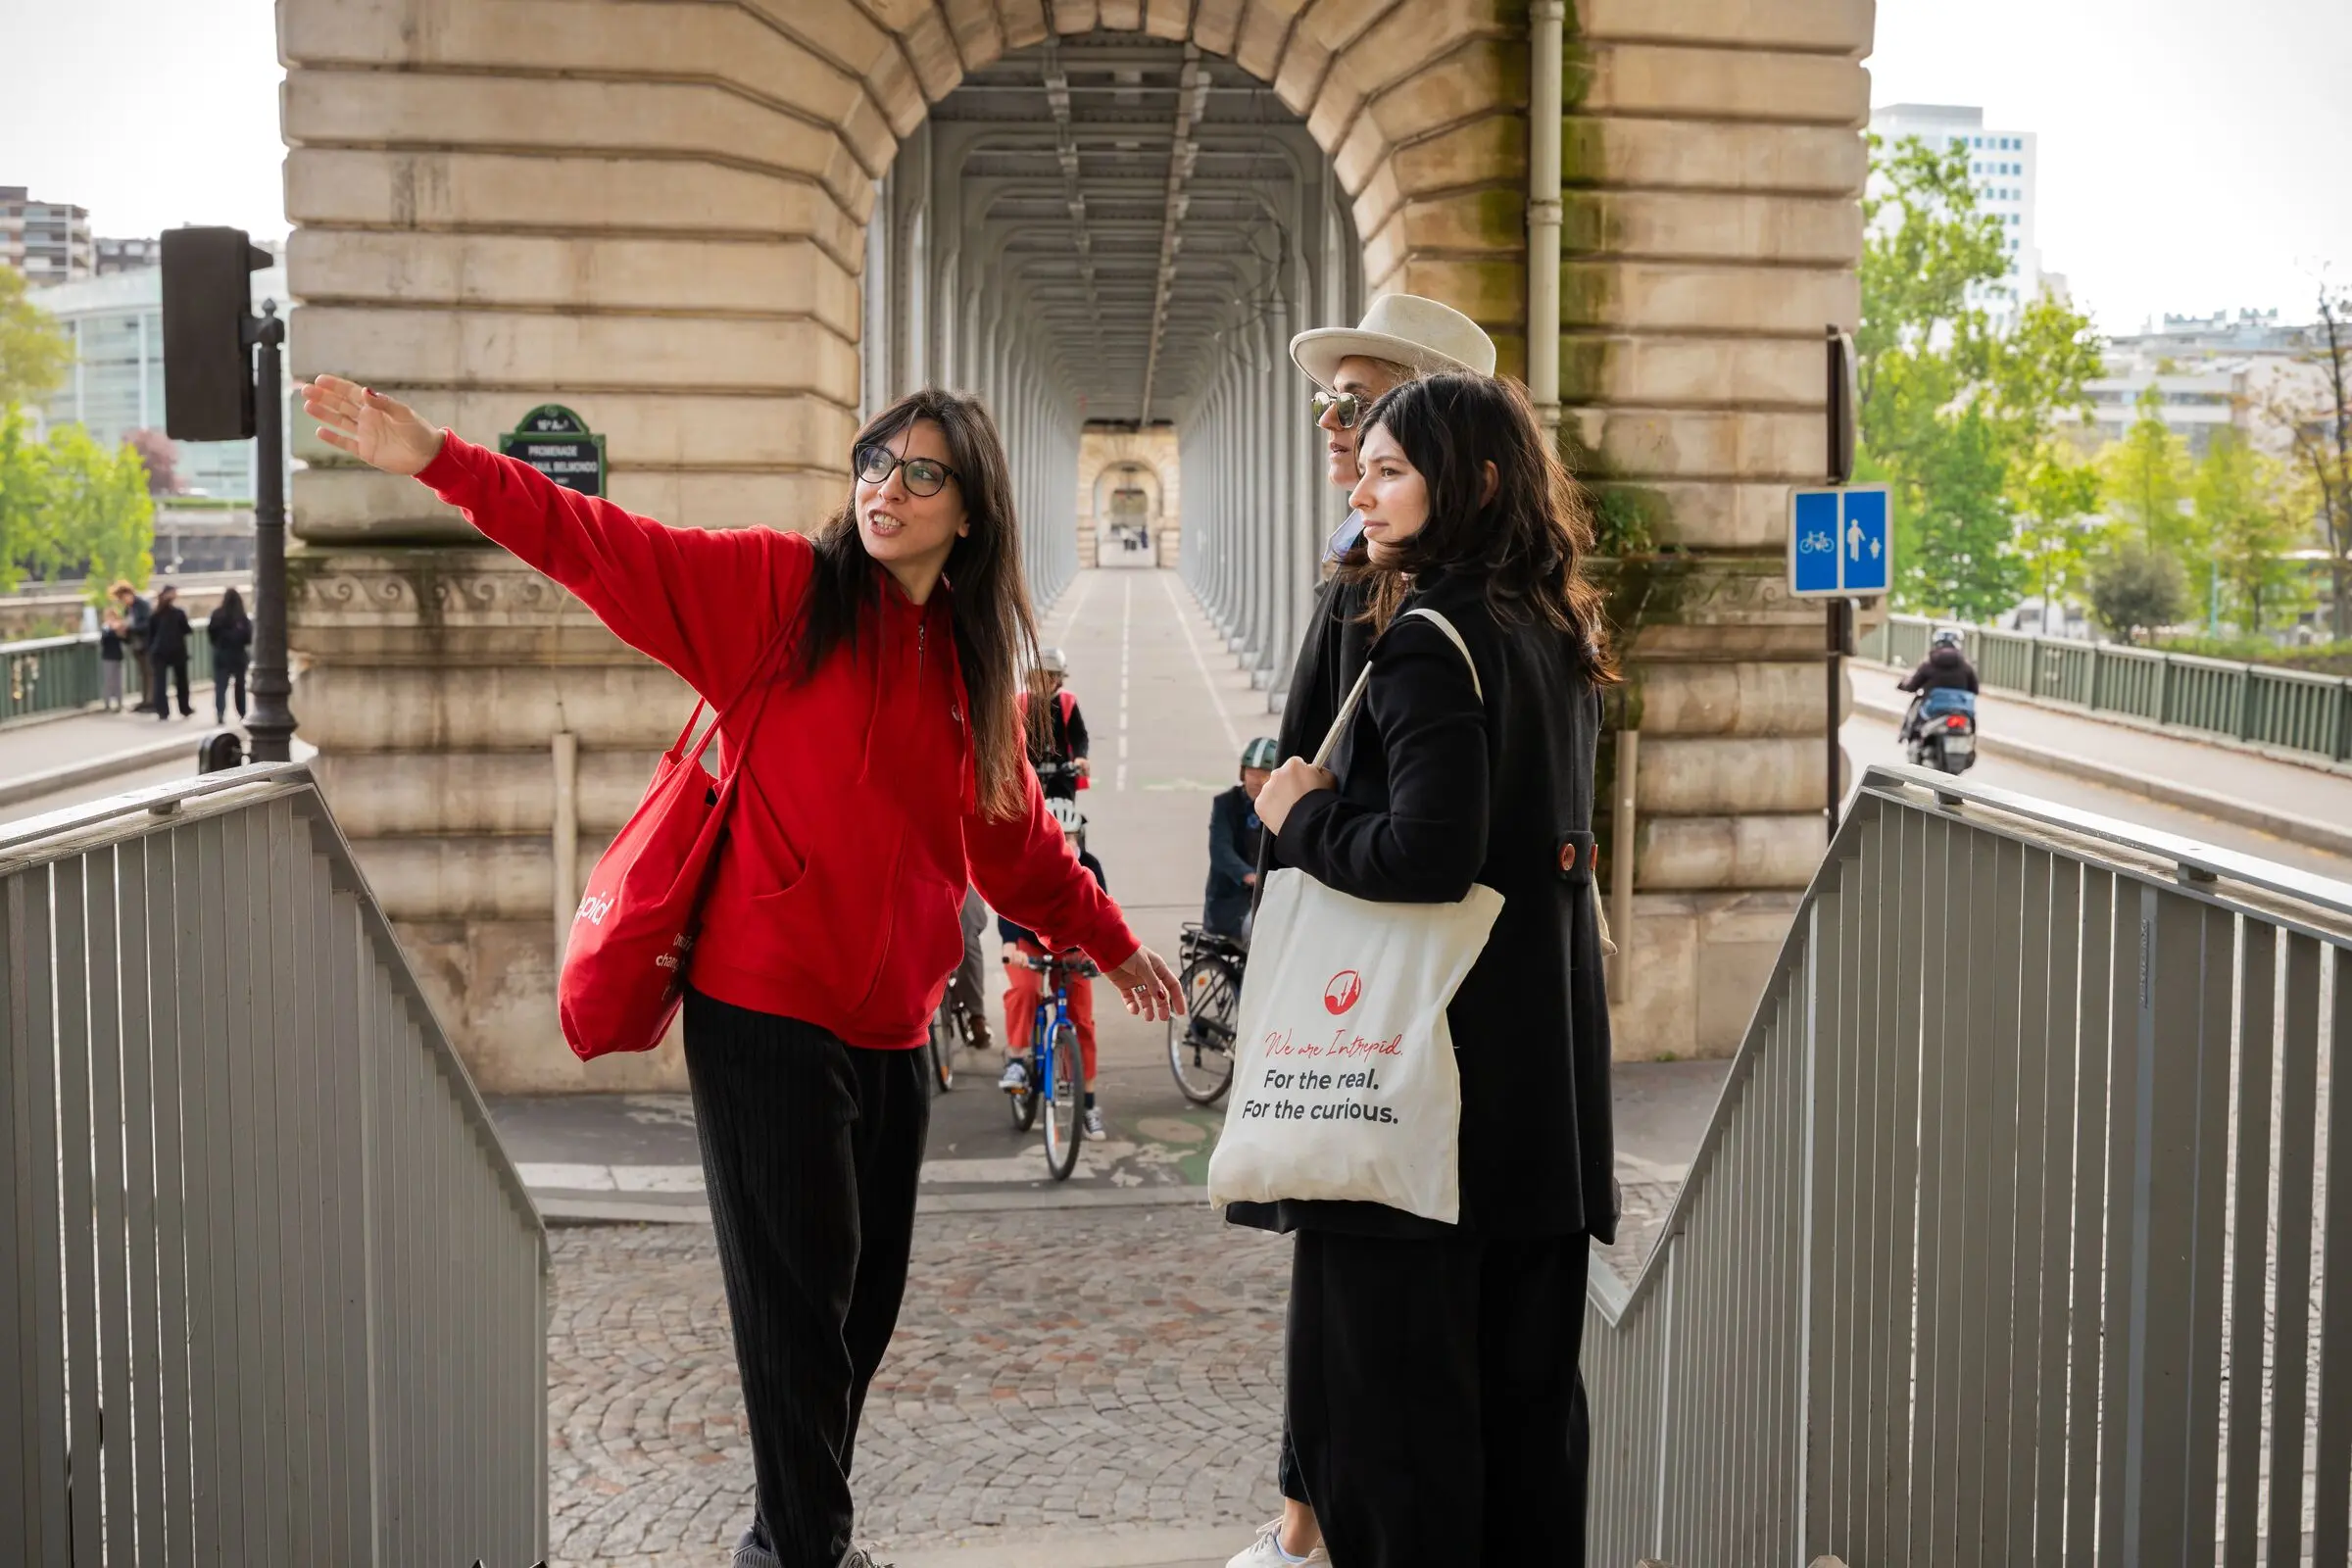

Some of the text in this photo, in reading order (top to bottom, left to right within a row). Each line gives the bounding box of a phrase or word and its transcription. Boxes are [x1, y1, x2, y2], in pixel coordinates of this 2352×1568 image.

[528, 445, 578, 457] PROMENADE
[553, 462, 598, 473] BELMONDO
[1265, 1028, 1403, 1062] We are Intrepid.
[1264, 1068, 1379, 1090] For the real.
[1242, 1098, 1398, 1124] For the curious.
